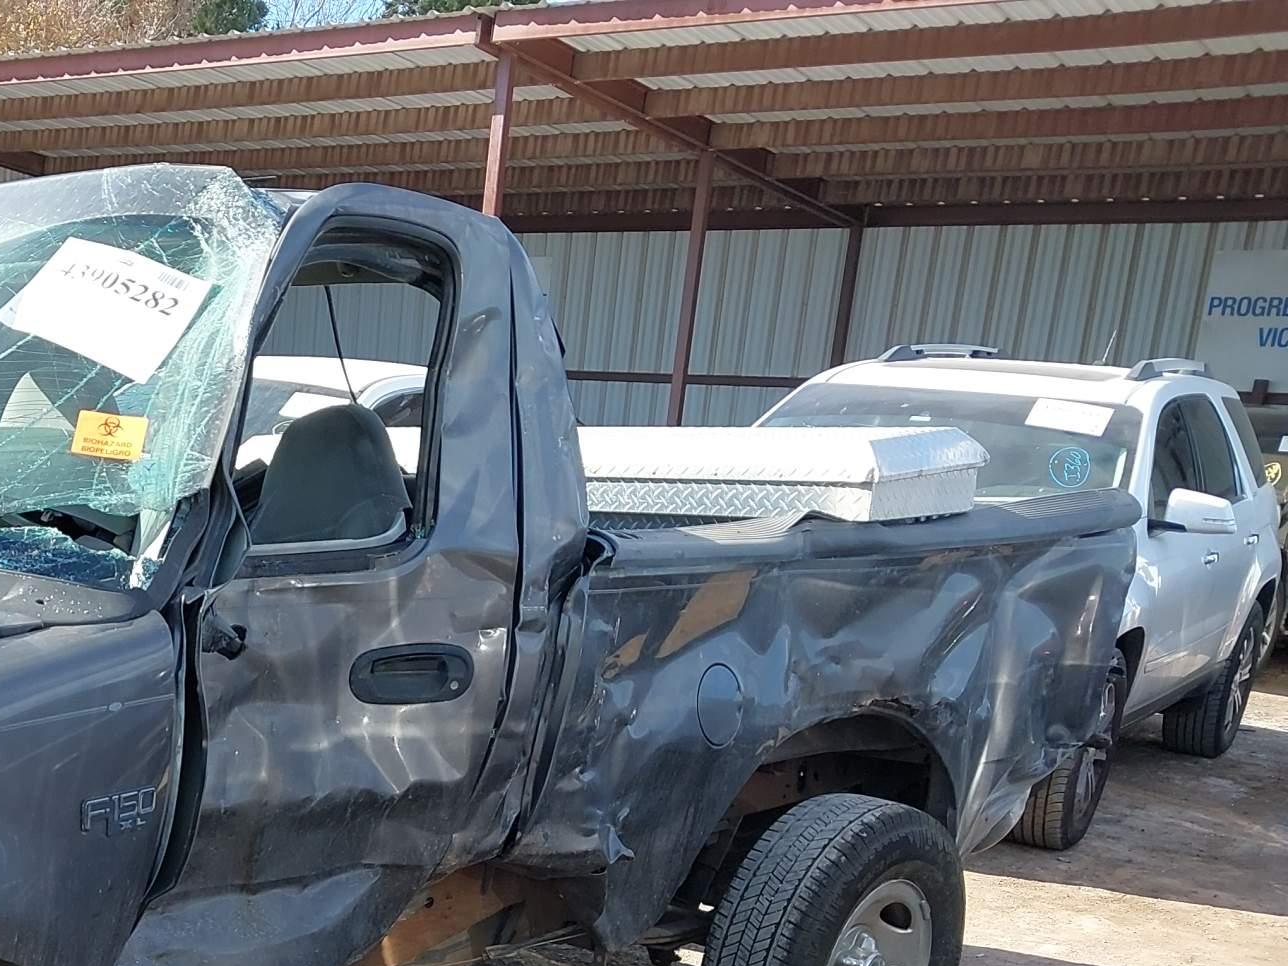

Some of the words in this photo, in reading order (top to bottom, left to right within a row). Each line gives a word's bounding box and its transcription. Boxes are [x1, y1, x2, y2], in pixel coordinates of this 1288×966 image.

[62, 263, 179, 316] 43905282
[83, 437, 132, 448] BIOHAZARD
[81, 445, 131, 457] BIOPELIGRO
